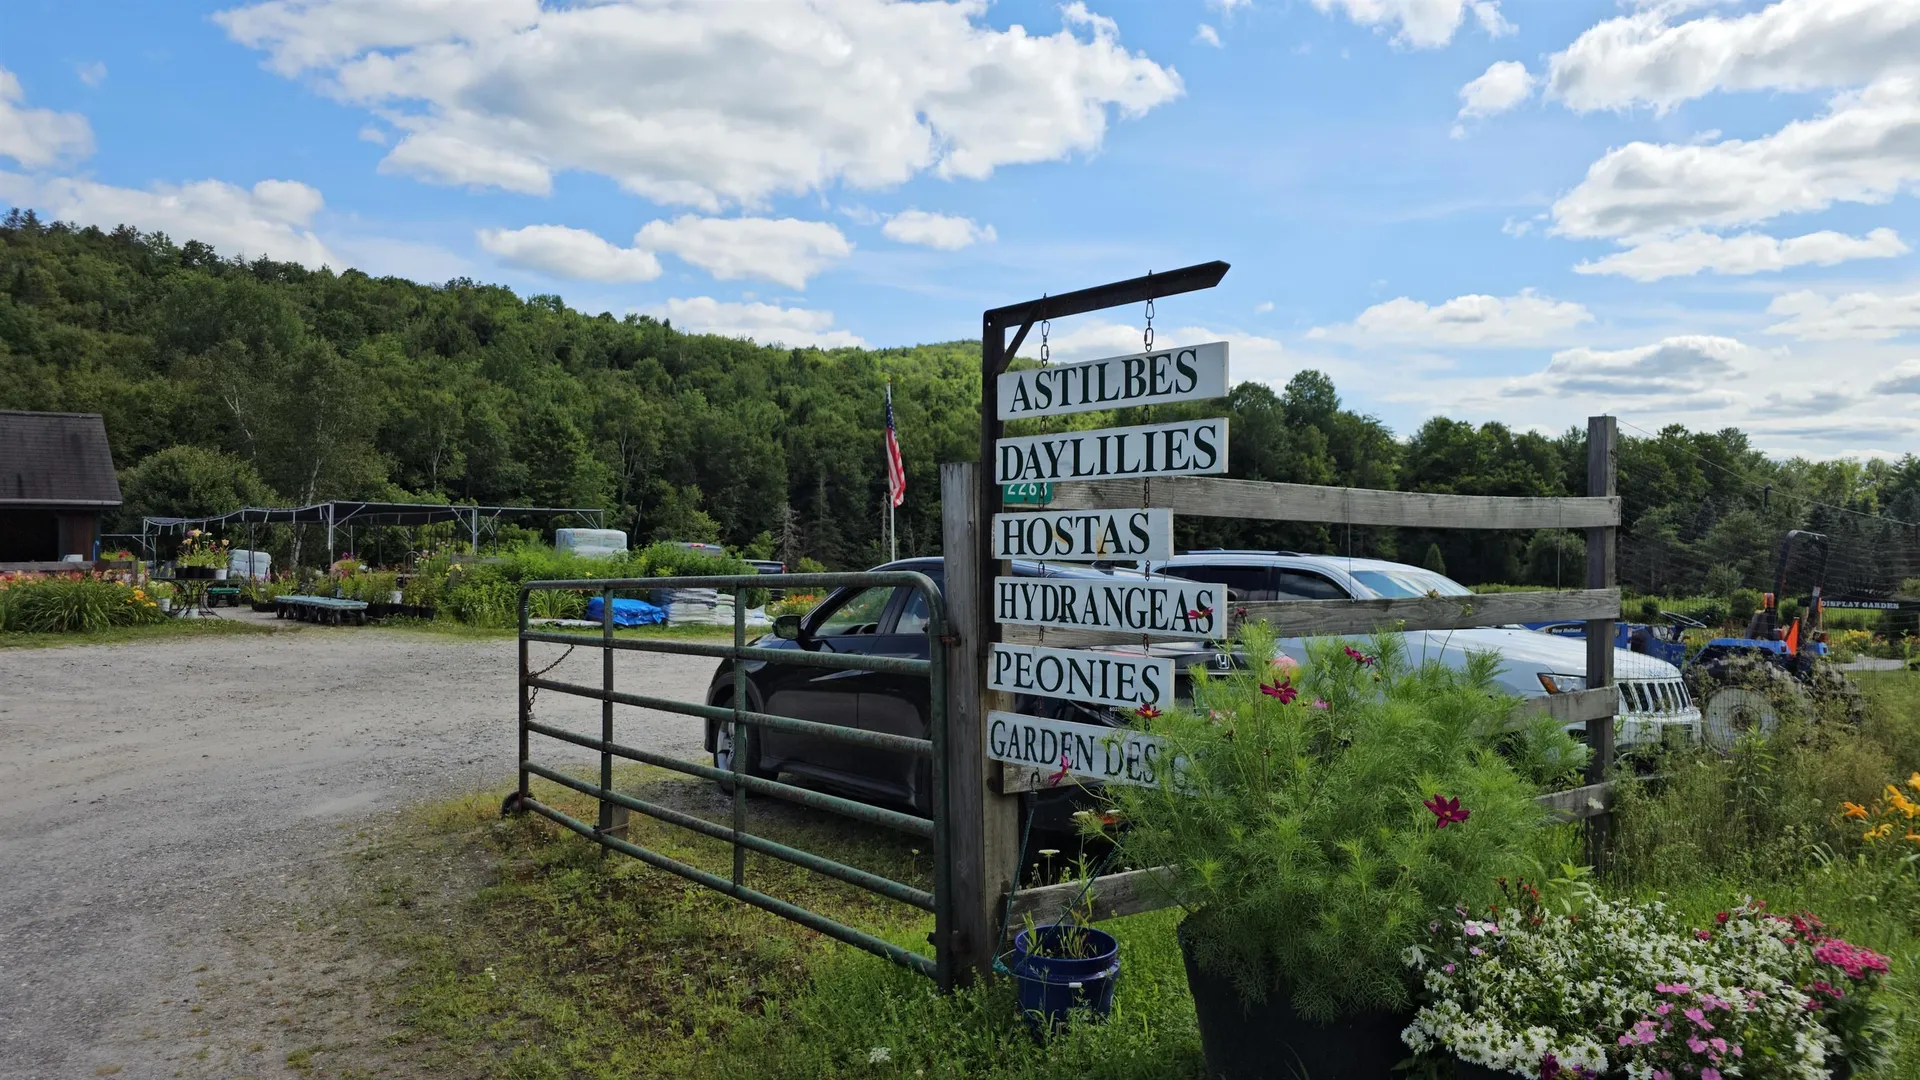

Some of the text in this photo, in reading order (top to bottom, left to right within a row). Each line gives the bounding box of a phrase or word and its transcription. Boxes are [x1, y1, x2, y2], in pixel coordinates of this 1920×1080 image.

[1010, 349, 1198, 413] ASTILBES
[1000, 425, 1217, 482] DAYLILIES
[1001, 512, 1150, 556] HOSTAS
[998, 582, 1214, 634] HYDRANGEAS
[1821, 600, 1900, 609] DISPLAY GARDEN
[993, 650, 1160, 705] PEONIES
[990, 719, 1096, 773] GARDEN
